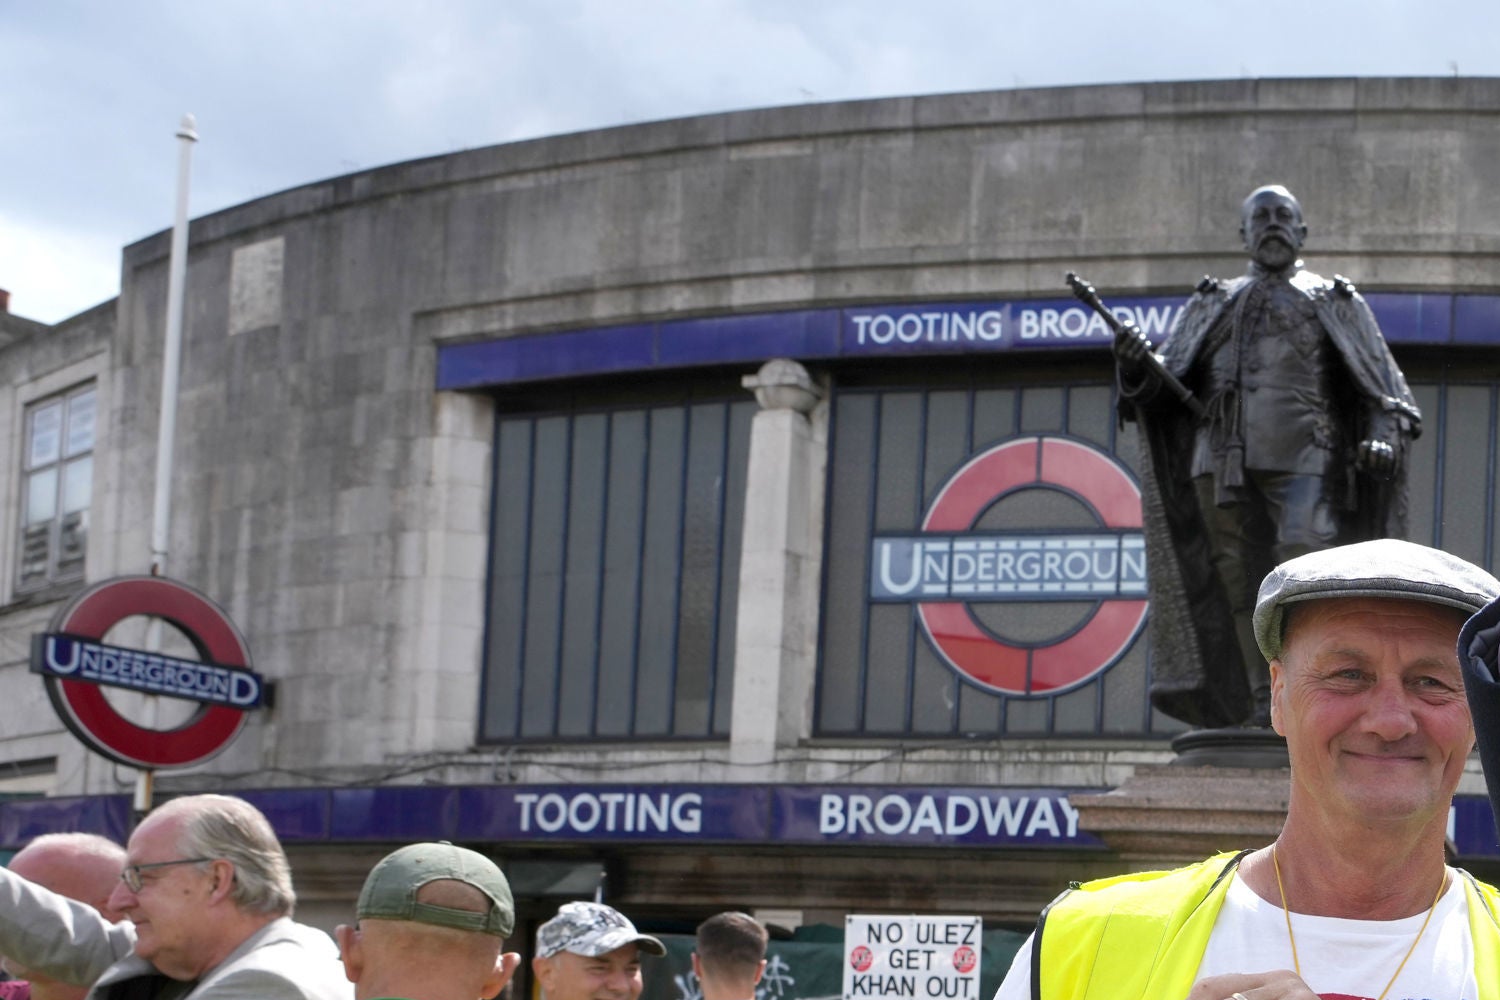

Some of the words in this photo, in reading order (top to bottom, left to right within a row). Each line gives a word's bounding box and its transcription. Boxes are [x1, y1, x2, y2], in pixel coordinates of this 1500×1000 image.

[852, 310, 1002, 344] TOOTING
[880, 542, 1146, 595] UNDERGROUN
[45, 636, 260, 705] UNDERGROUND
[514, 793, 702, 832] TOOTING
[819, 794, 1080, 837] BROADWAY
[867, 922, 904, 944] NO
[916, 923, 976, 945] ULEZ
[889, 948, 936, 970] GET
[852, 975, 915, 996] KHAN
[926, 976, 974, 998] OUT
